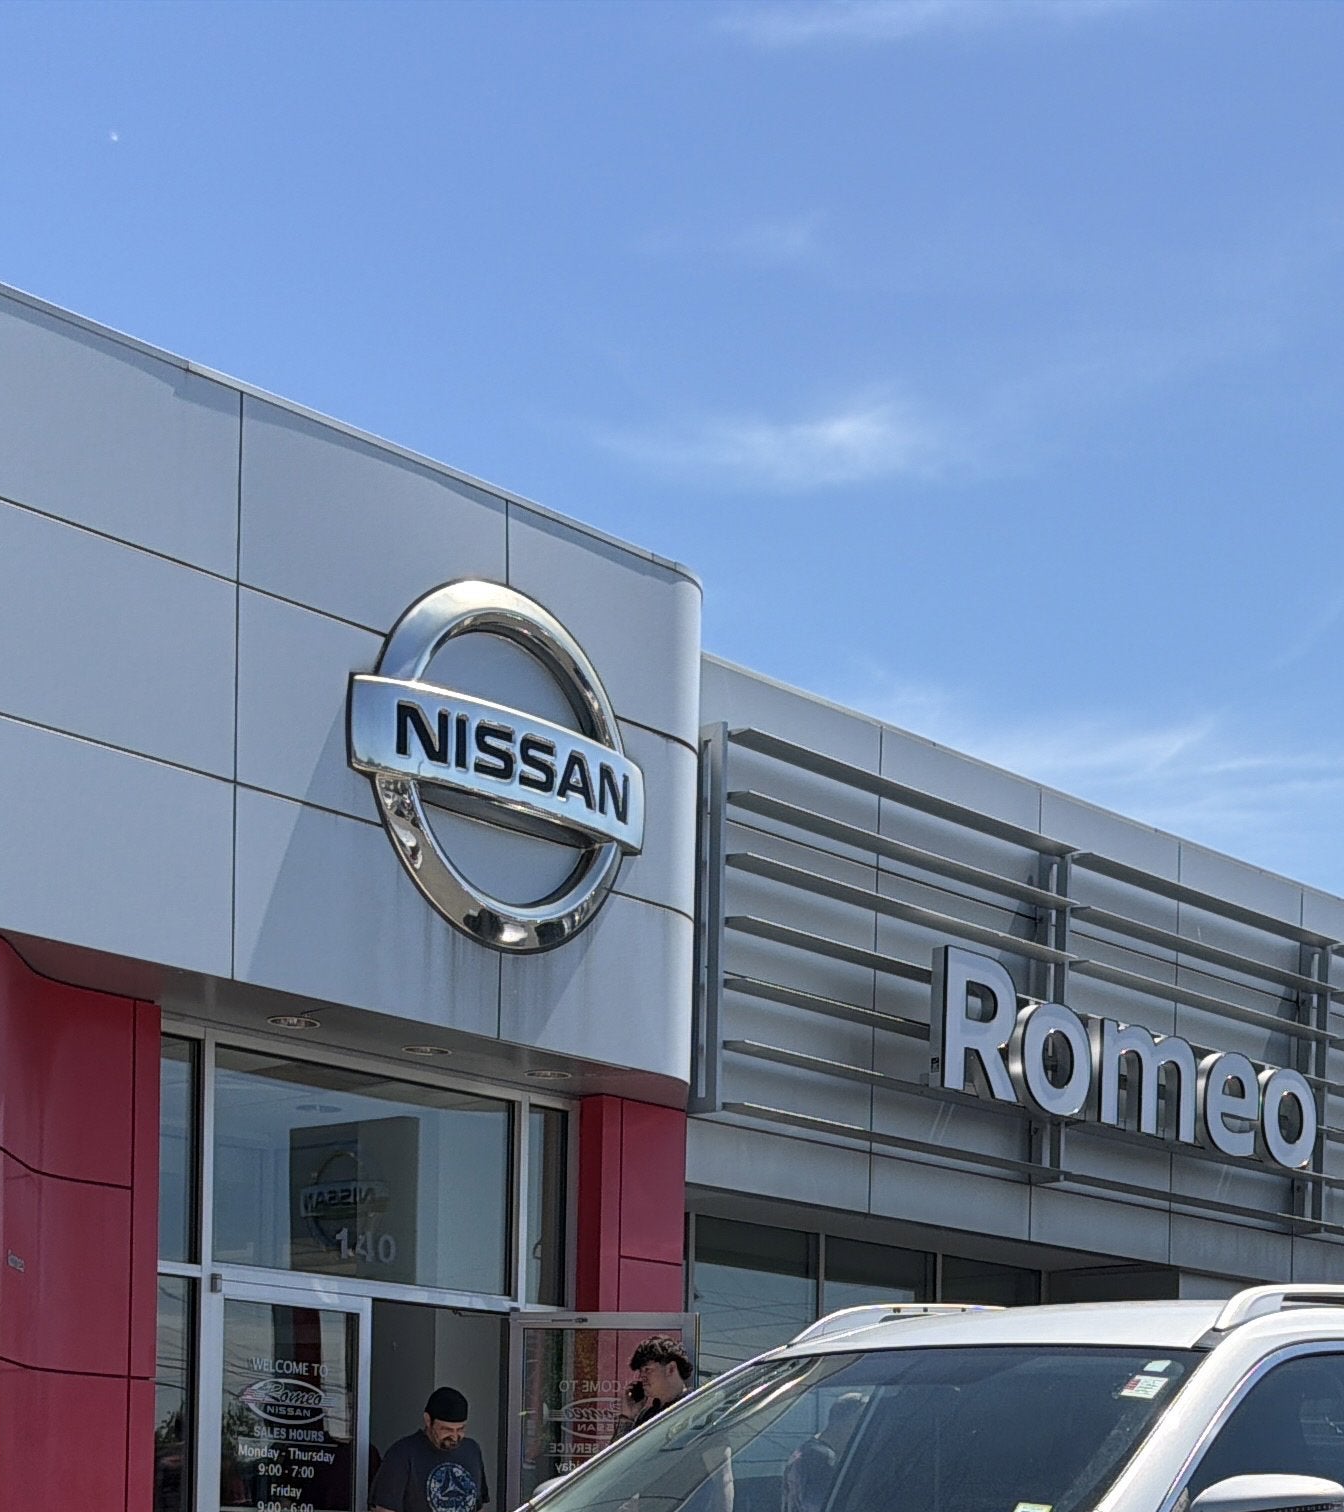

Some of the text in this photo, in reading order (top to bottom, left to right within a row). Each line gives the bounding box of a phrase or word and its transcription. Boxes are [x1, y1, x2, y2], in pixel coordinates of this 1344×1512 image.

[395, 700, 630, 825] NISSAN
[930, 945, 1317, 1170] Romeo
[336, 1227, 397, 1264] 140
[252, 1358, 329, 1378] WELCOME TO
[258, 1381, 323, 1406] Romeo
[266, 1405, 311, 1417] NISSAN
[253, 1426, 325, 1442] SALES HOURS
[238, 1443, 280, 1460] Monday
[288, 1447, 336, 1464] Thursday
[258, 1463, 283, 1476] 9:00
[291, 1466, 315, 1479] 7:00
[270, 1483, 303, 1499] Friday
